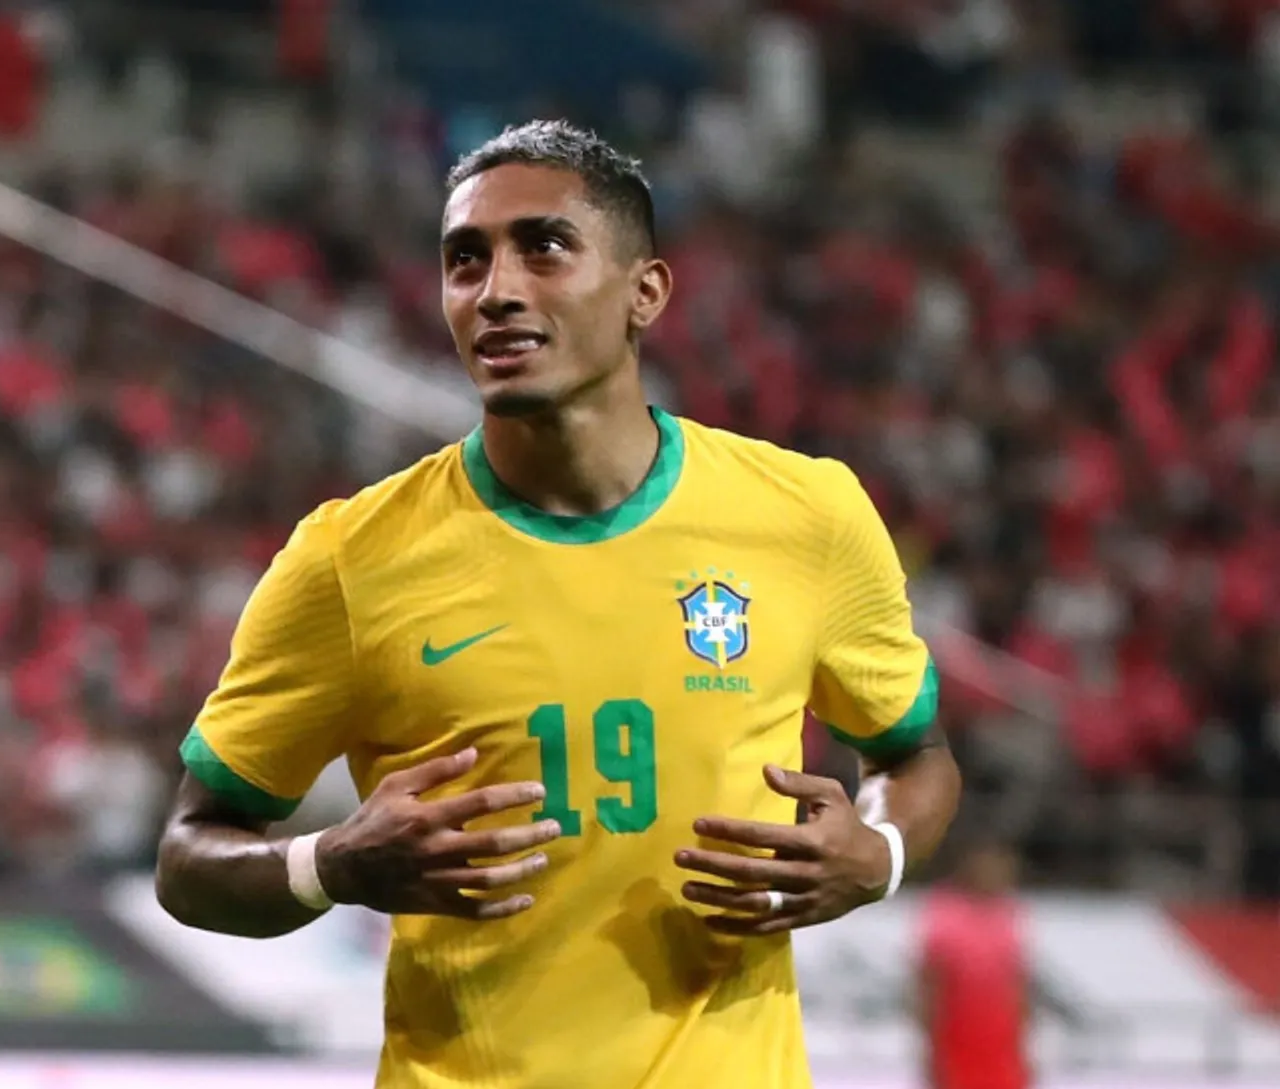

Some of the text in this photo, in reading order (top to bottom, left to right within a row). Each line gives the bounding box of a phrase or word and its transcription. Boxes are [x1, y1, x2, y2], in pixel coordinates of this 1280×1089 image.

[702, 616, 727, 628] CBF
[684, 675, 754, 693] BRASIL
[527, 698, 658, 836] 19
